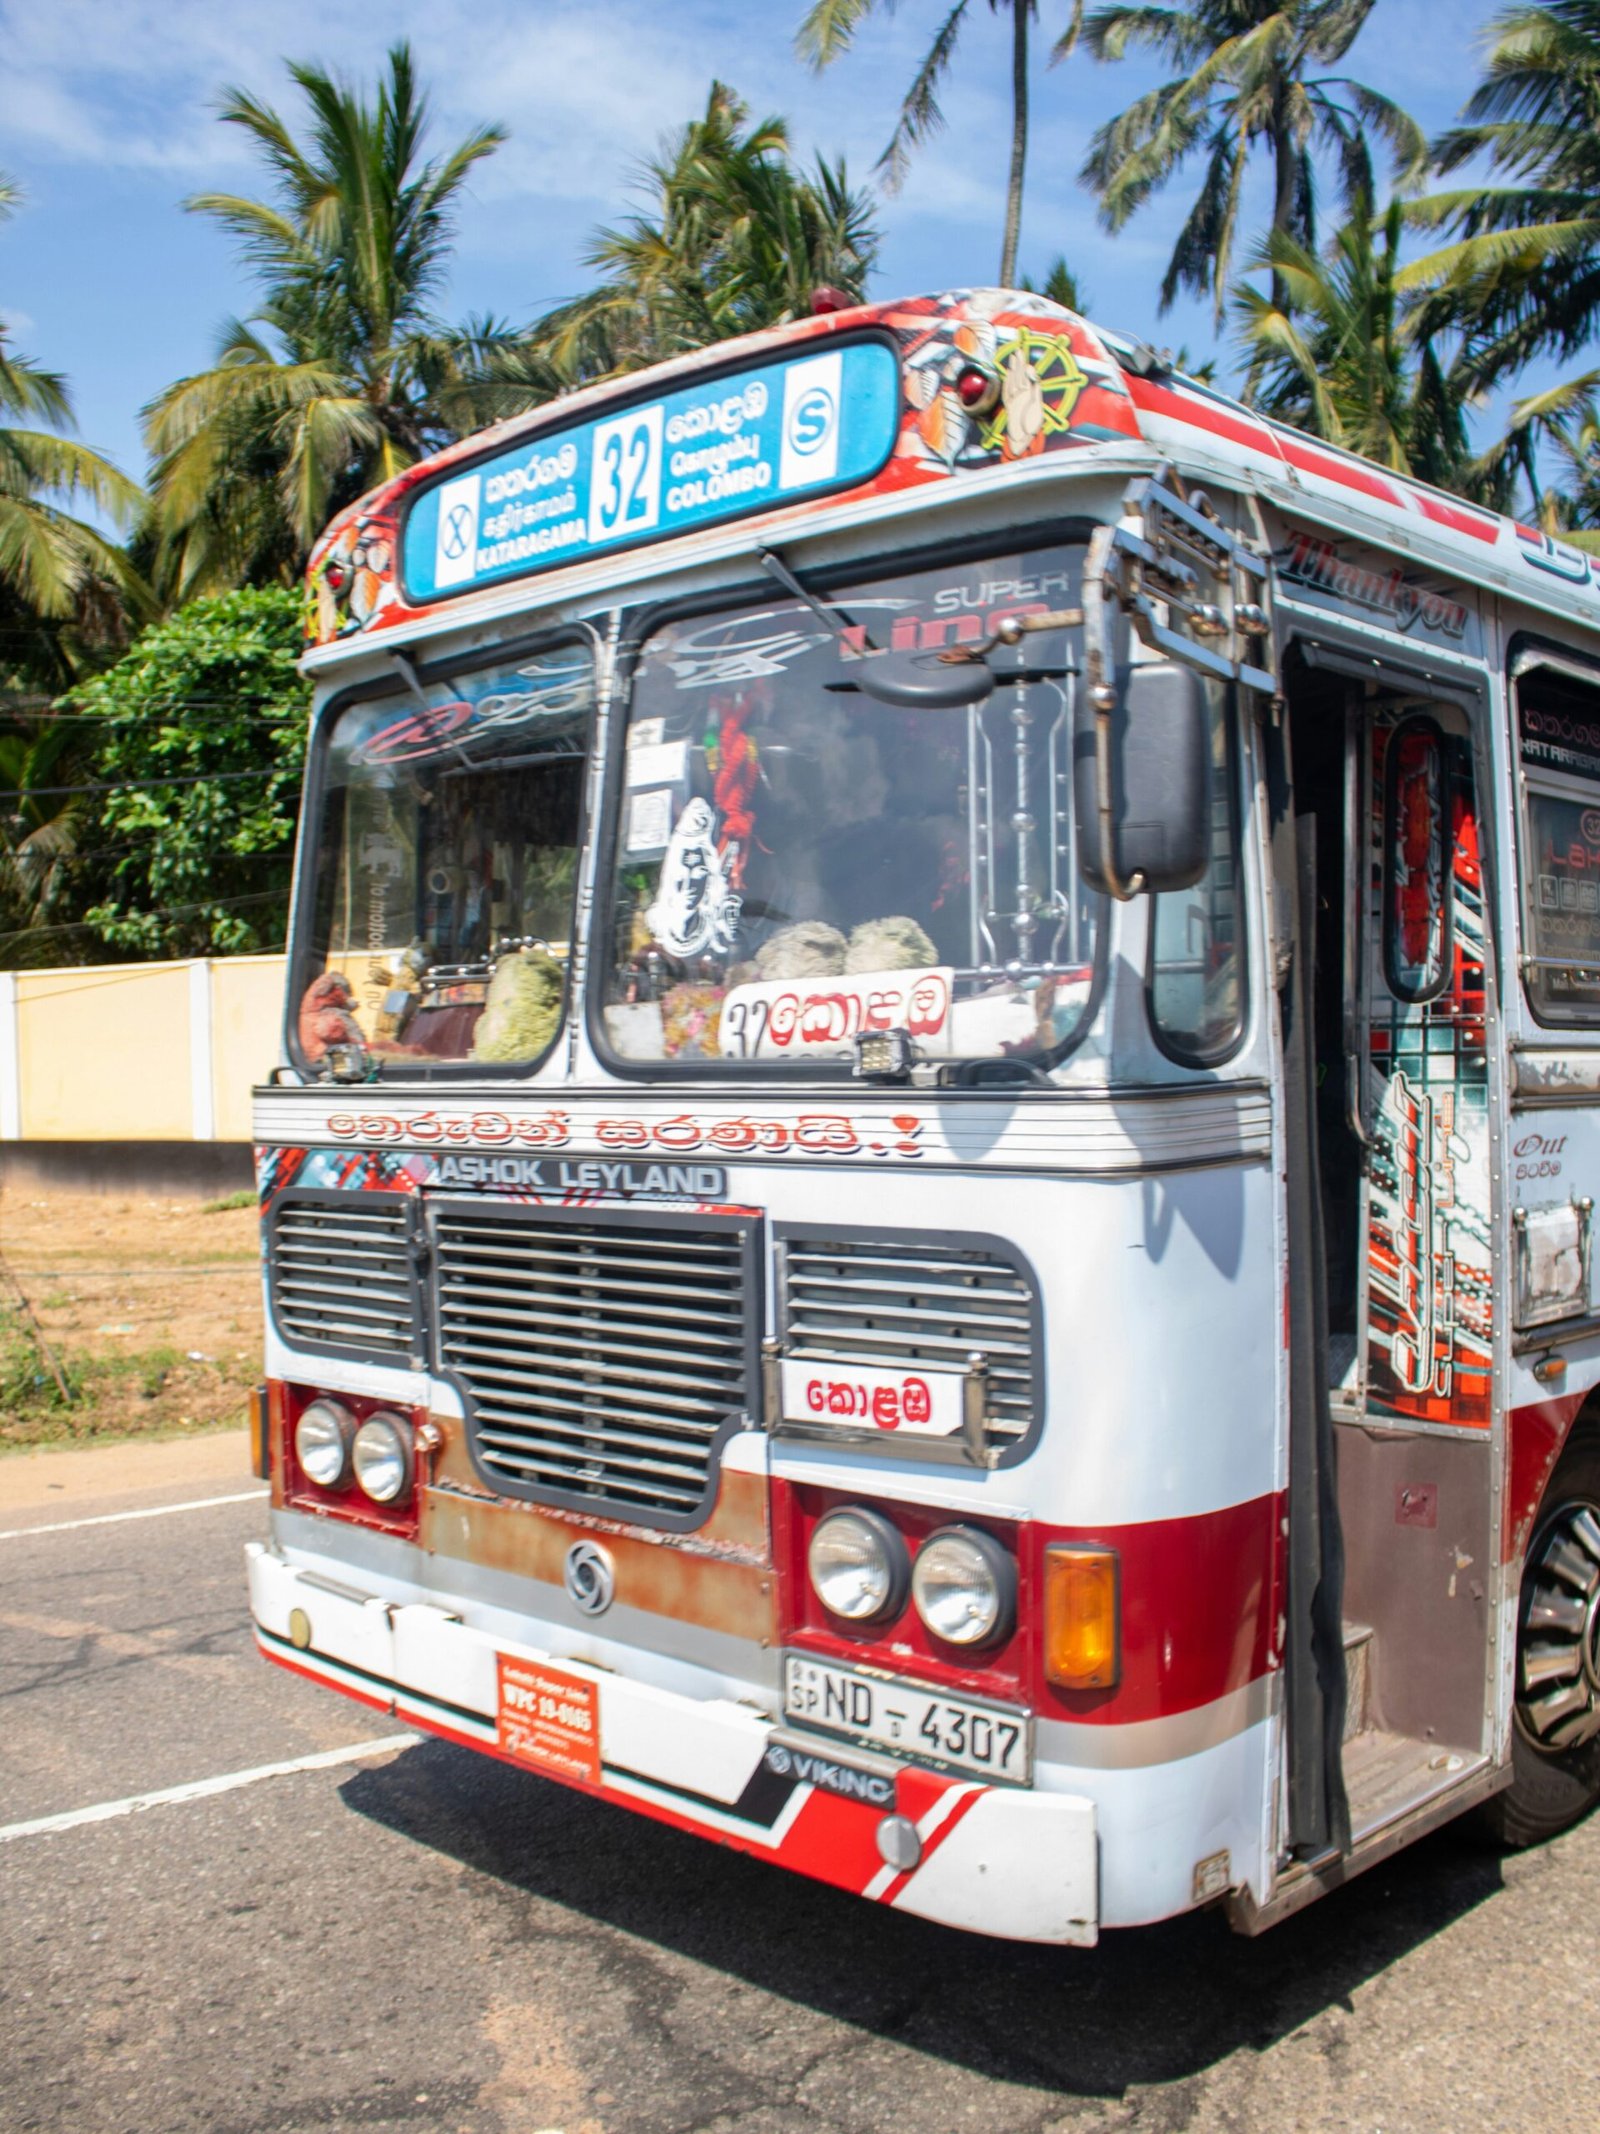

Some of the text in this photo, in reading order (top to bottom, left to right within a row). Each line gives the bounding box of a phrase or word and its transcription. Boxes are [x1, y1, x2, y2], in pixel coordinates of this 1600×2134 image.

[600, 424, 650, 528] 32
[666, 461, 772, 512] COLOMBO
[475, 518, 587, 571] KATARAGAMA
[933, 572, 1070, 614] SUPER
[1513, 1133, 1568, 1157] Out
[439, 1156, 723, 1196] ASHOK LEYLAND
[791, 1684, 819, 1713] SP
[792, 1754, 895, 1801] VIKING
